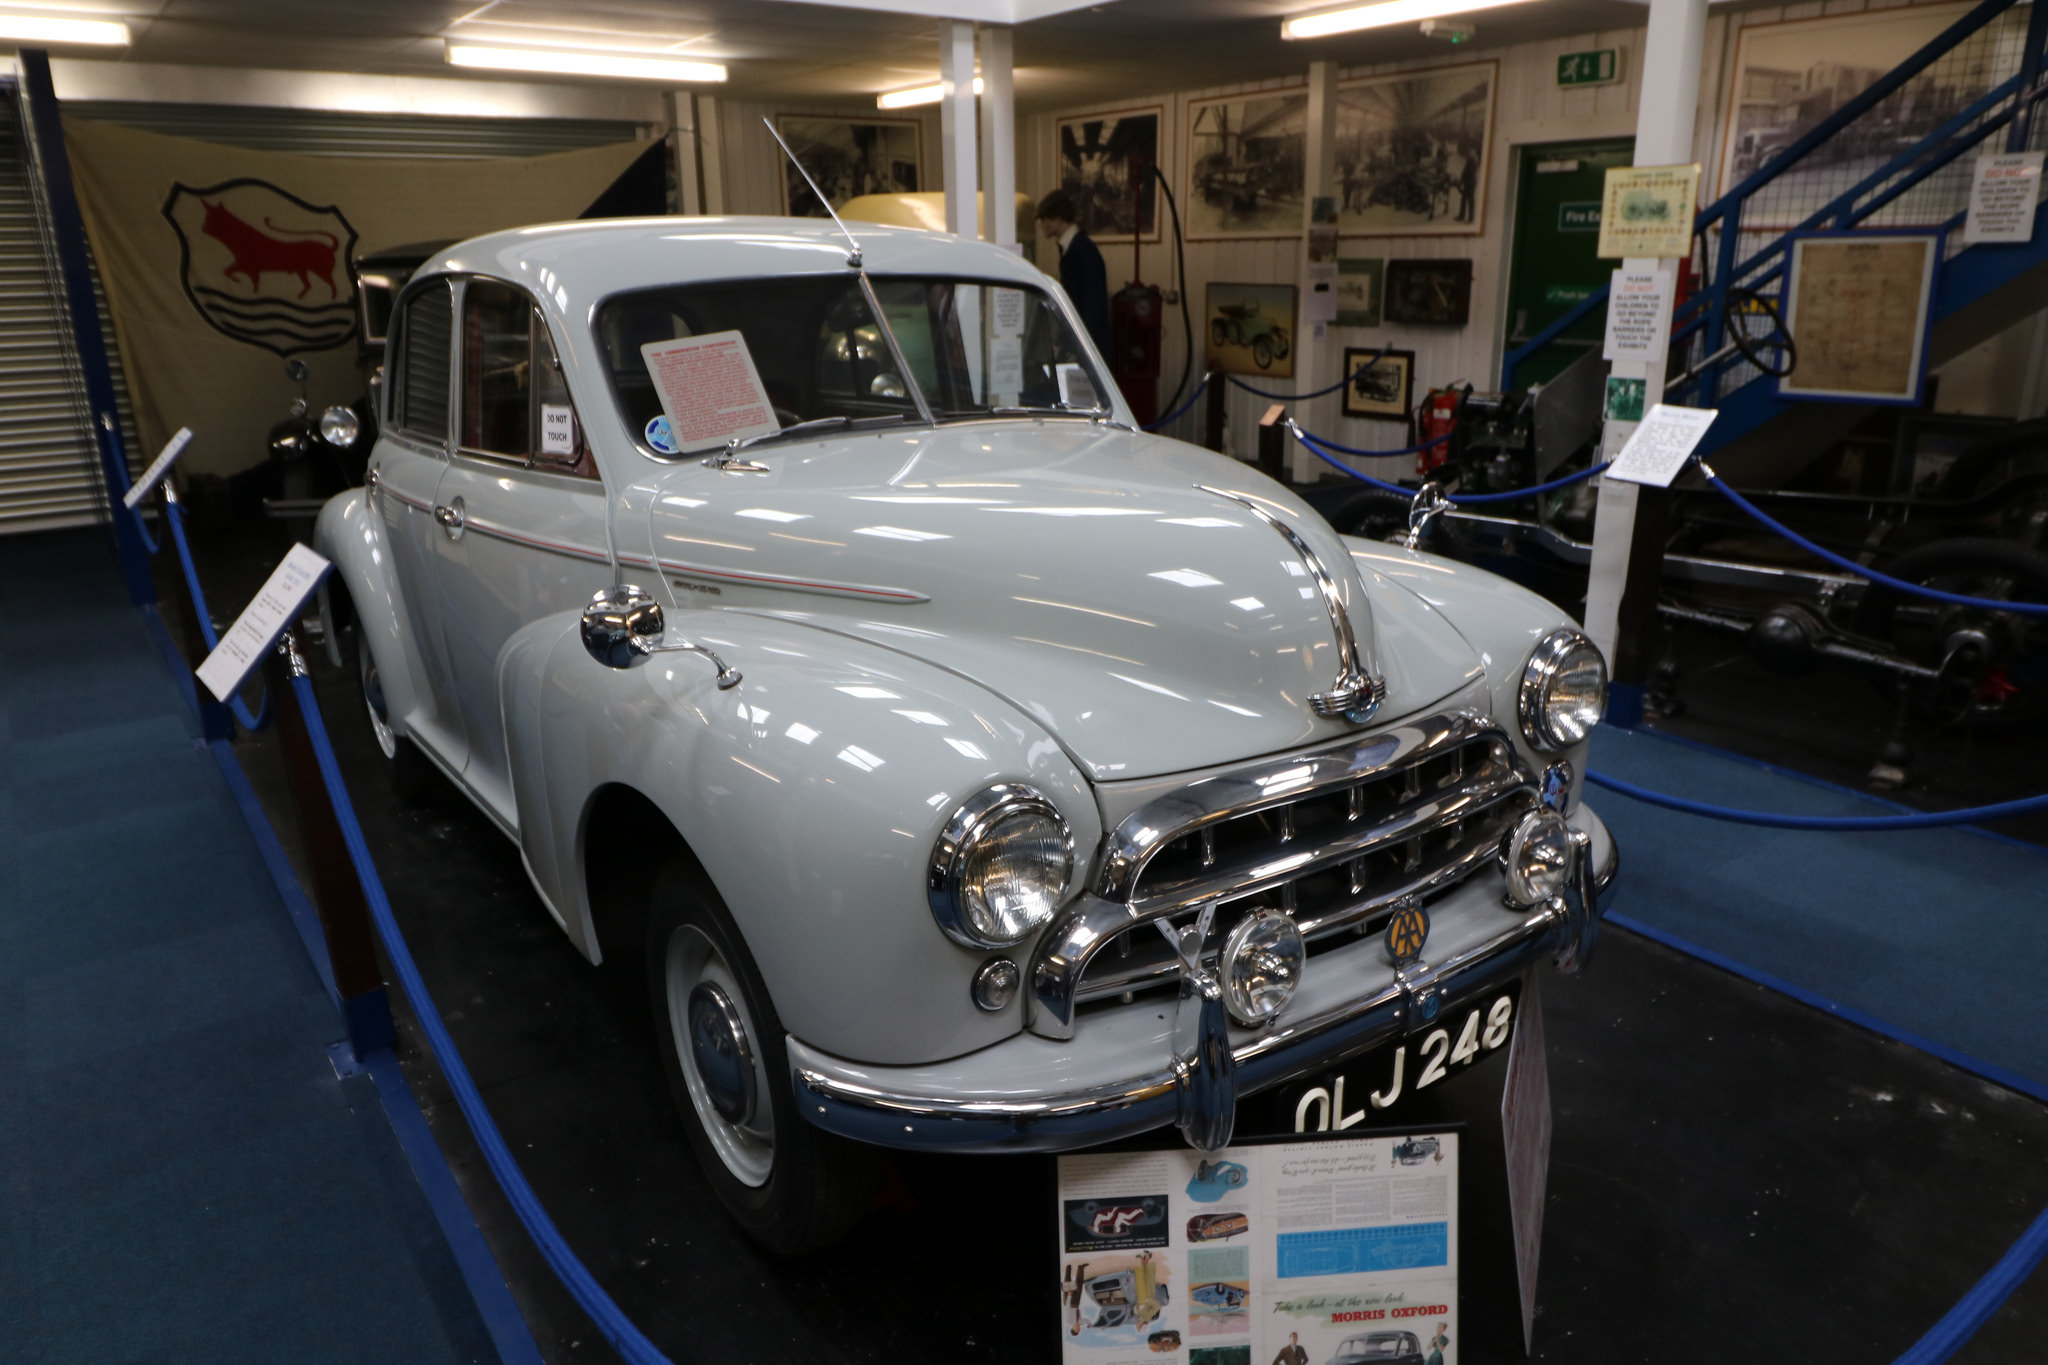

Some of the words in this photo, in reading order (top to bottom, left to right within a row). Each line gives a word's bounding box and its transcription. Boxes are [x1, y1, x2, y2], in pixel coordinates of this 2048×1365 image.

[1626, 275, 1653, 283] PLEASE
[547, 414, 555, 423] DO
[555, 414, 567, 424] NOT
[547, 431, 567, 442] TOUCH
[1416, 996, 1512, 1089] 248
[1273, 1301, 1294, 1313] Take
[1306, 1299, 1326, 1310] look
[1334, 1298, 1346, 1308] at
[1347, 1296, 1361, 1307] the
[1365, 1297, 1381, 1305] new
[1385, 1292, 1404, 1304] look
[1331, 1309, 1386, 1323] MORRIS
[1391, 1304, 1448, 1319] OXFORD
